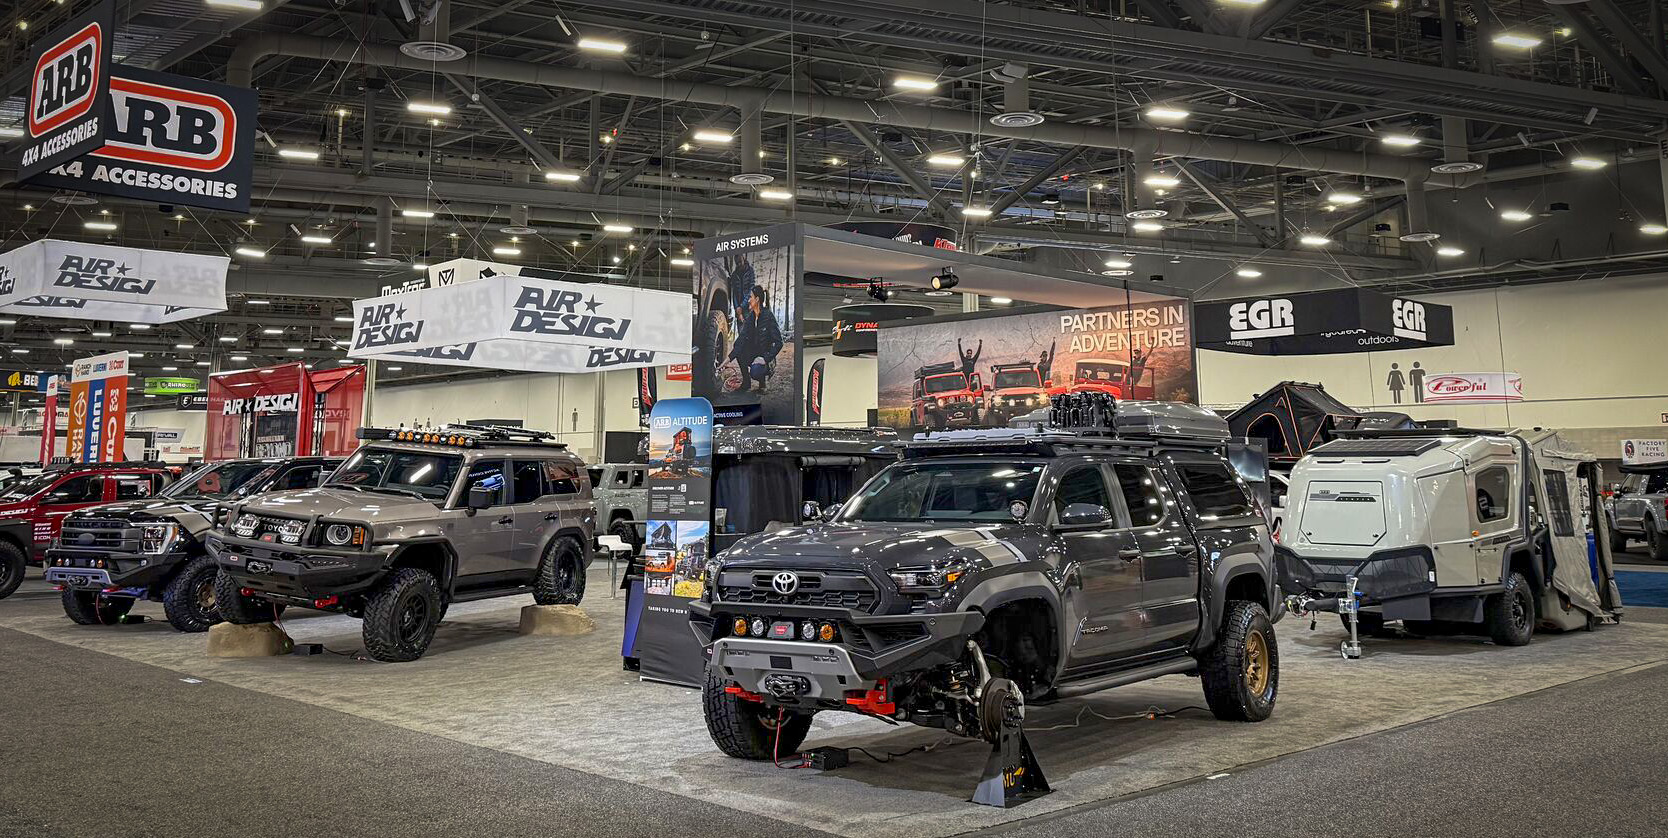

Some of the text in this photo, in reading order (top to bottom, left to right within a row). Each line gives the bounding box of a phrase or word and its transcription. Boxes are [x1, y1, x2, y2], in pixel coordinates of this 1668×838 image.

[37, 43, 93, 120] ARB
[22, 117, 98, 167] 4X4 ACCESSORIES
[91, 164, 238, 199] ACCESSORIES
[715, 234, 769, 252] AIR SYSTEMS
[59, 254, 115, 276] AIR
[53, 271, 157, 295] DESIGN
[513, 286, 583, 314] AIR
[359, 303, 395, 329] AIR
[510, 309, 631, 341] DESIGN
[1060, 305, 1184, 334] PARTNERS IN
[1229, 299, 1295, 331] EGR
[1392, 299, 1426, 332] EGR
[354, 320, 424, 350] DESIGN
[1069, 326, 1186, 354] ADVENTURE
[223, 398, 244, 416] AIR
[672, 415, 708, 426] ALTITUDE
